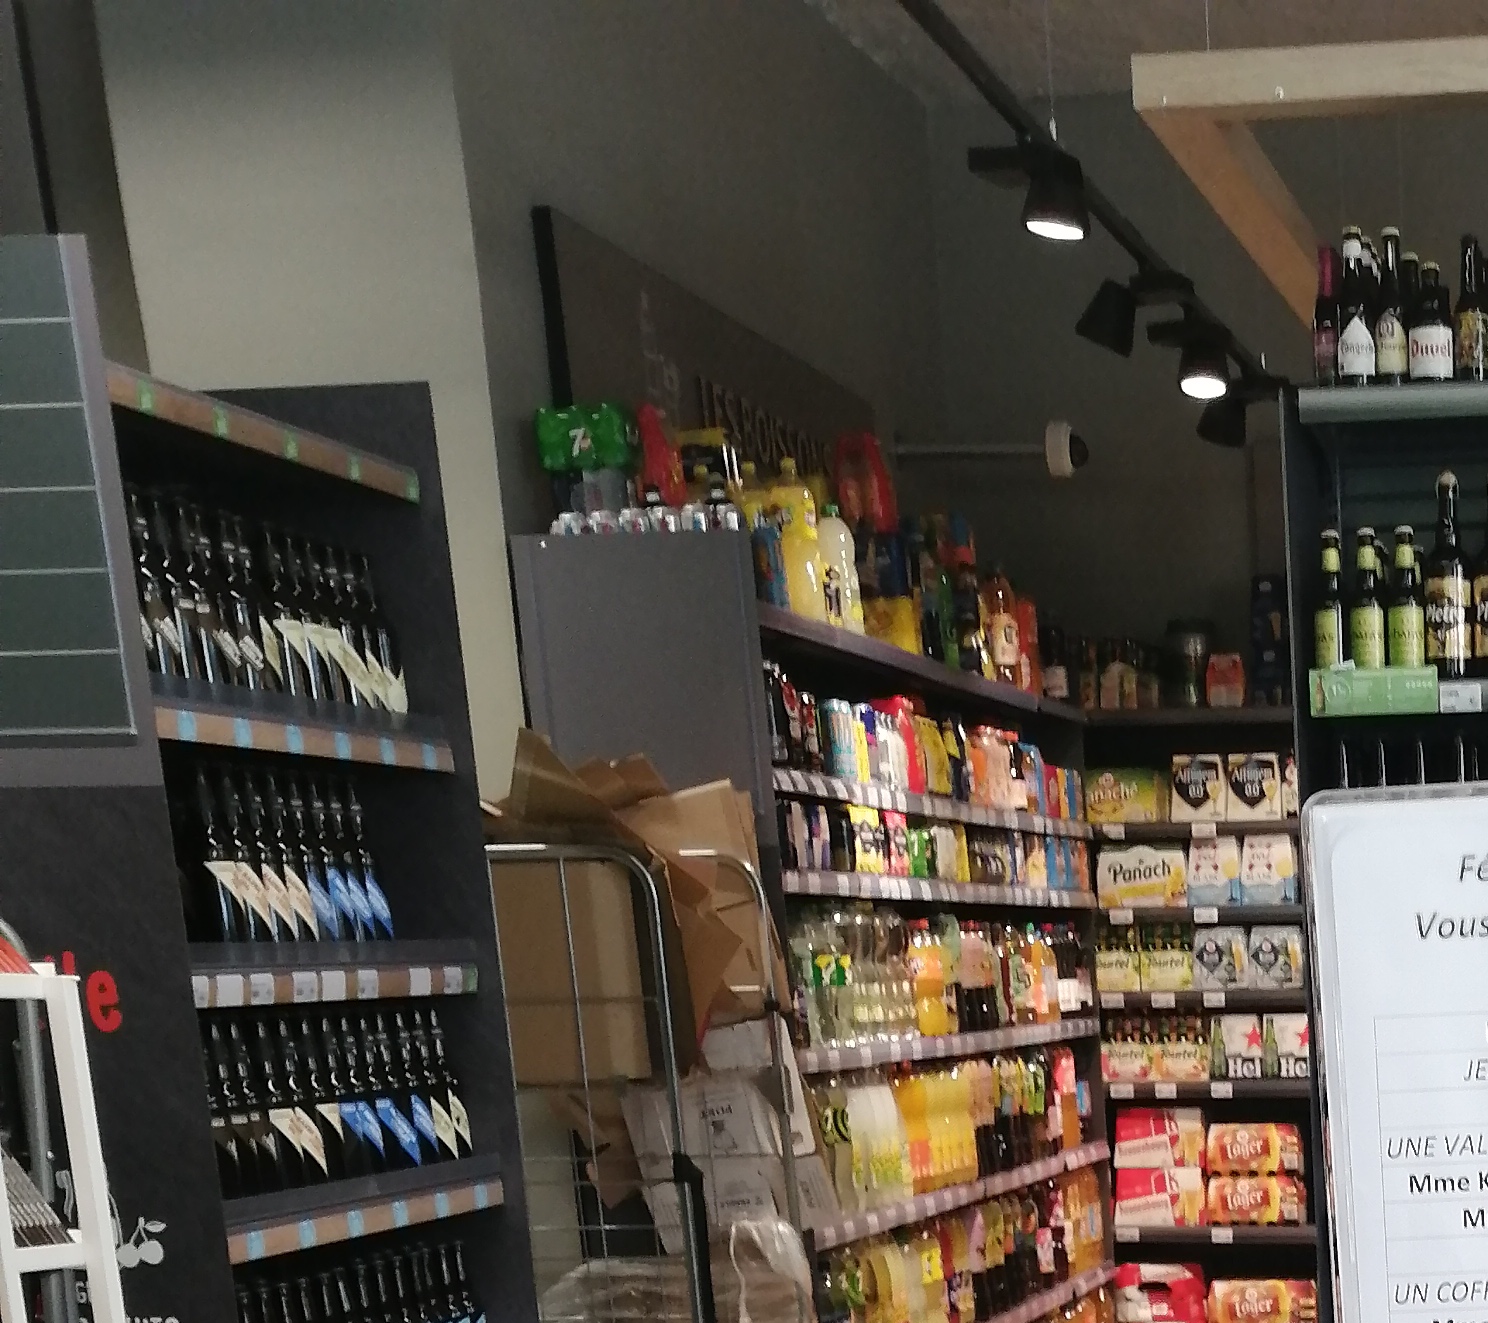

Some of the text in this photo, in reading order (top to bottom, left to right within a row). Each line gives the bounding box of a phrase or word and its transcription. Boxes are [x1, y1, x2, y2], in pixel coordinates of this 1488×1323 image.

[1386, 1133, 1436, 1160] UNE
[1408, 1169, 1471, 1195] Mme
[1394, 1281, 1430, 1306] UN
